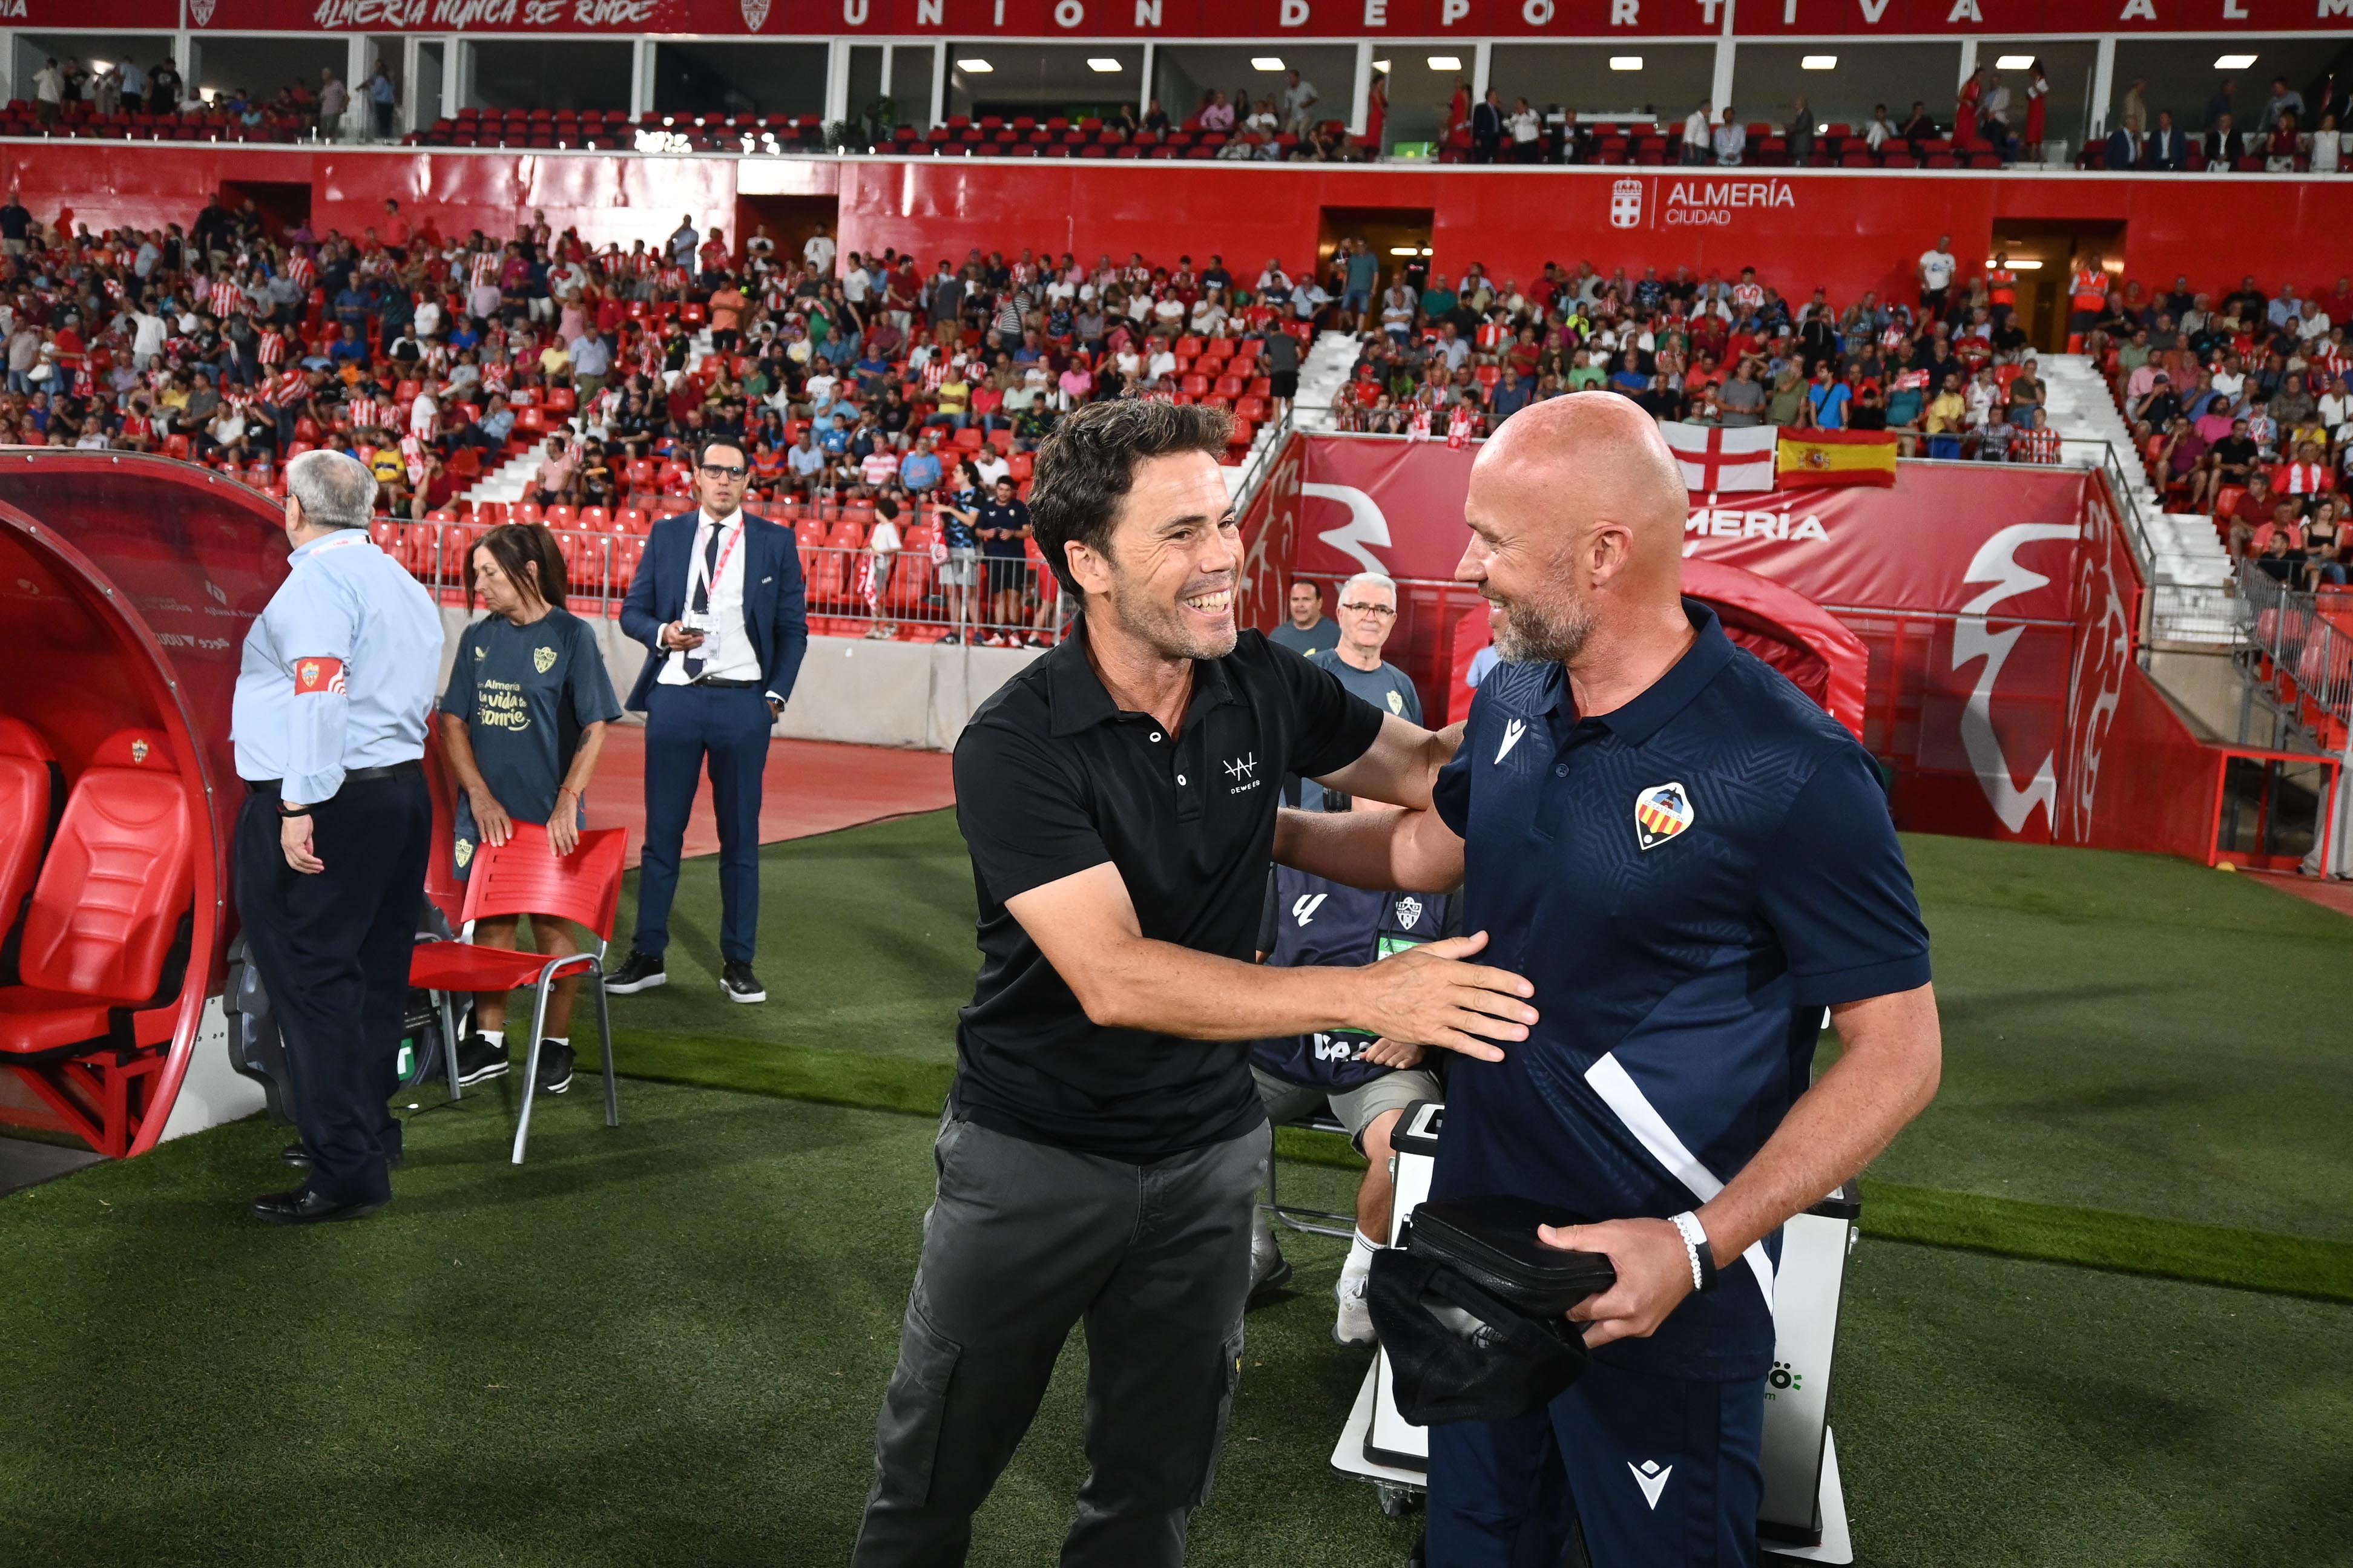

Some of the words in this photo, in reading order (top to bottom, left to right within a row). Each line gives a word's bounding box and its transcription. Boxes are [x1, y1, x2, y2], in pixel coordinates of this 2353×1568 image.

[523, 0, 567, 25] SE
[574, 0, 658, 26] RINDE
[1667, 178, 1795, 208] ALMERÍA
[1666, 209, 1731, 226] CIUDAD
[484, 679, 521, 692] Almería
[488, 692, 518, 710] vida
[518, 697, 527, 708] te
[1231, 779, 1260, 795] DEWEES
